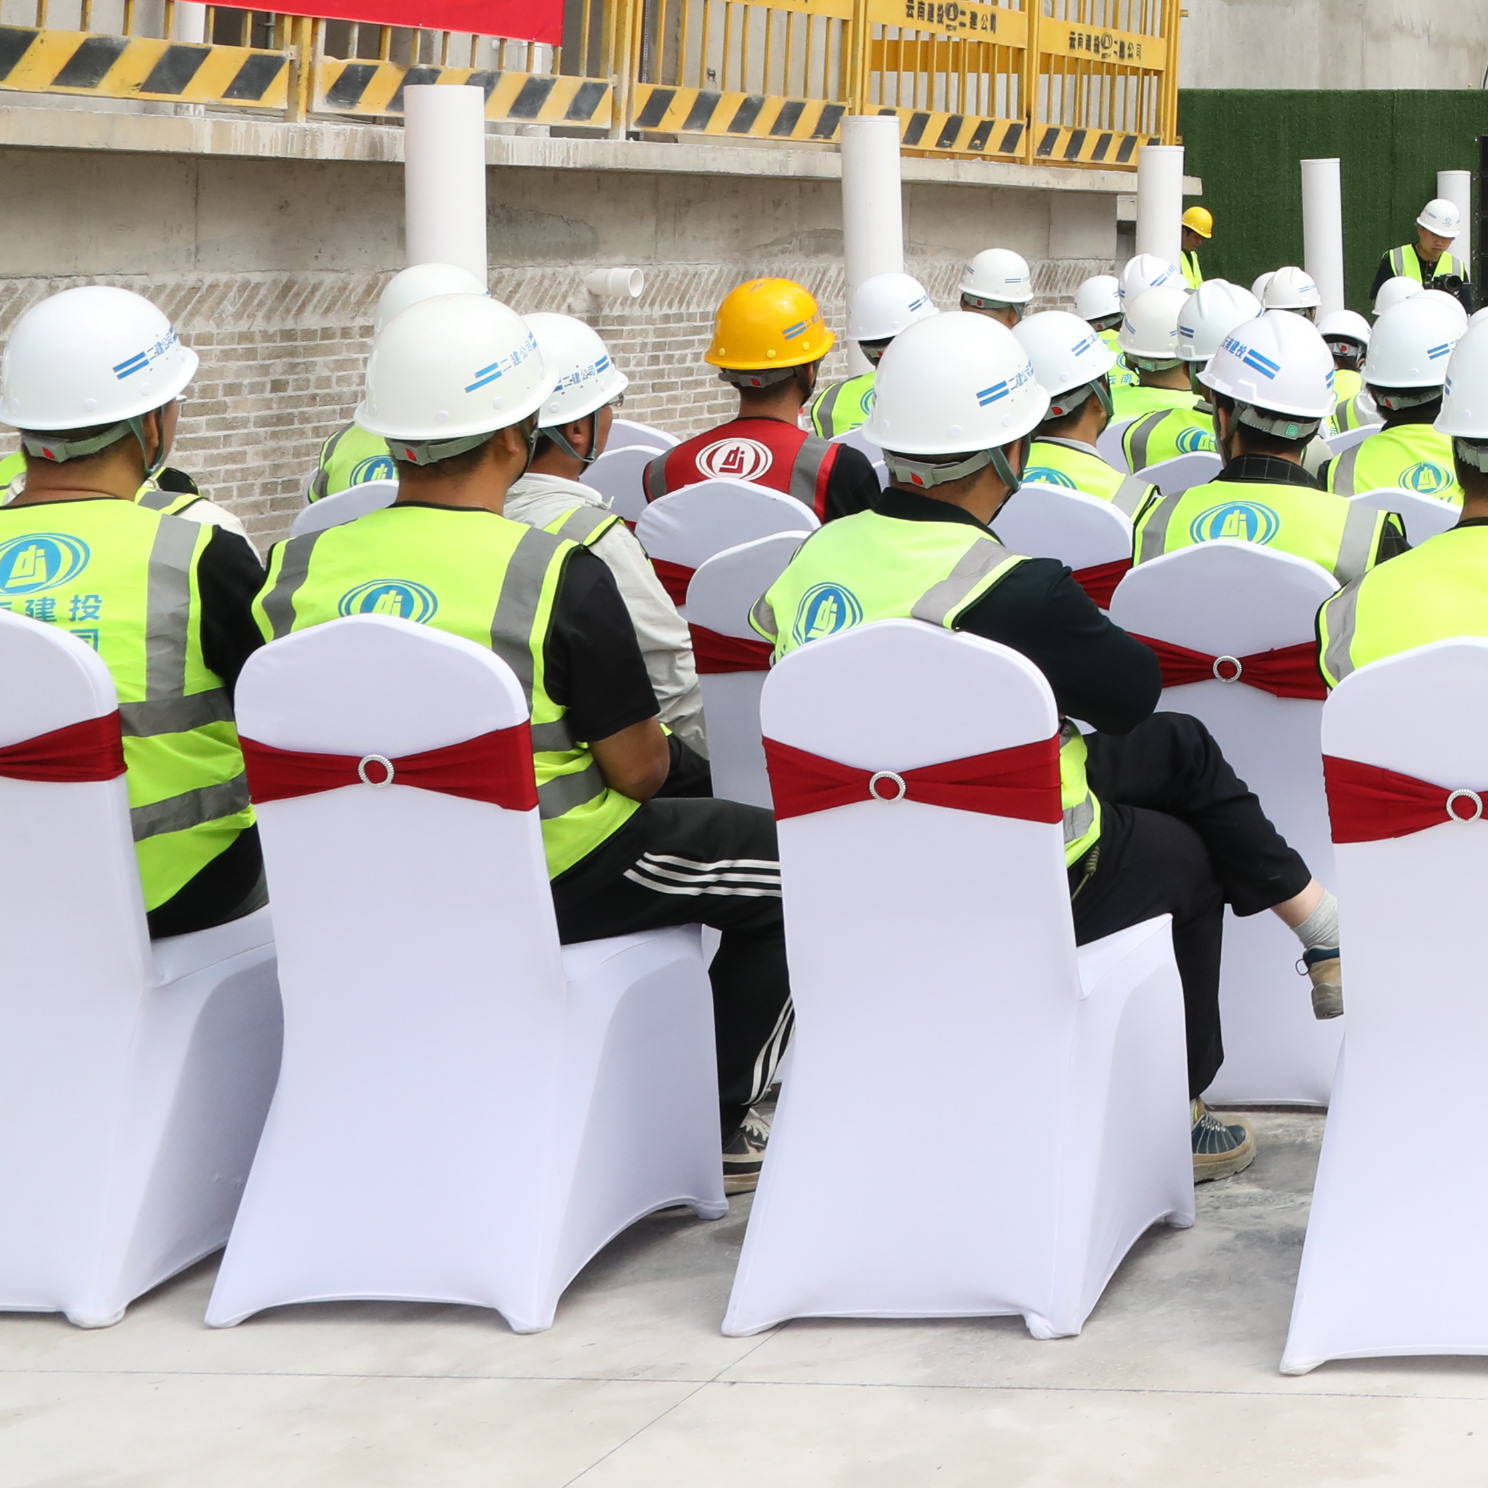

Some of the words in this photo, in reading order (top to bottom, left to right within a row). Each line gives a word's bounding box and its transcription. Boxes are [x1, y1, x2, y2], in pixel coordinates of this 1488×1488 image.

[958, 9, 998, 34] 二建公司
[0, 594, 103, 624] 建投
